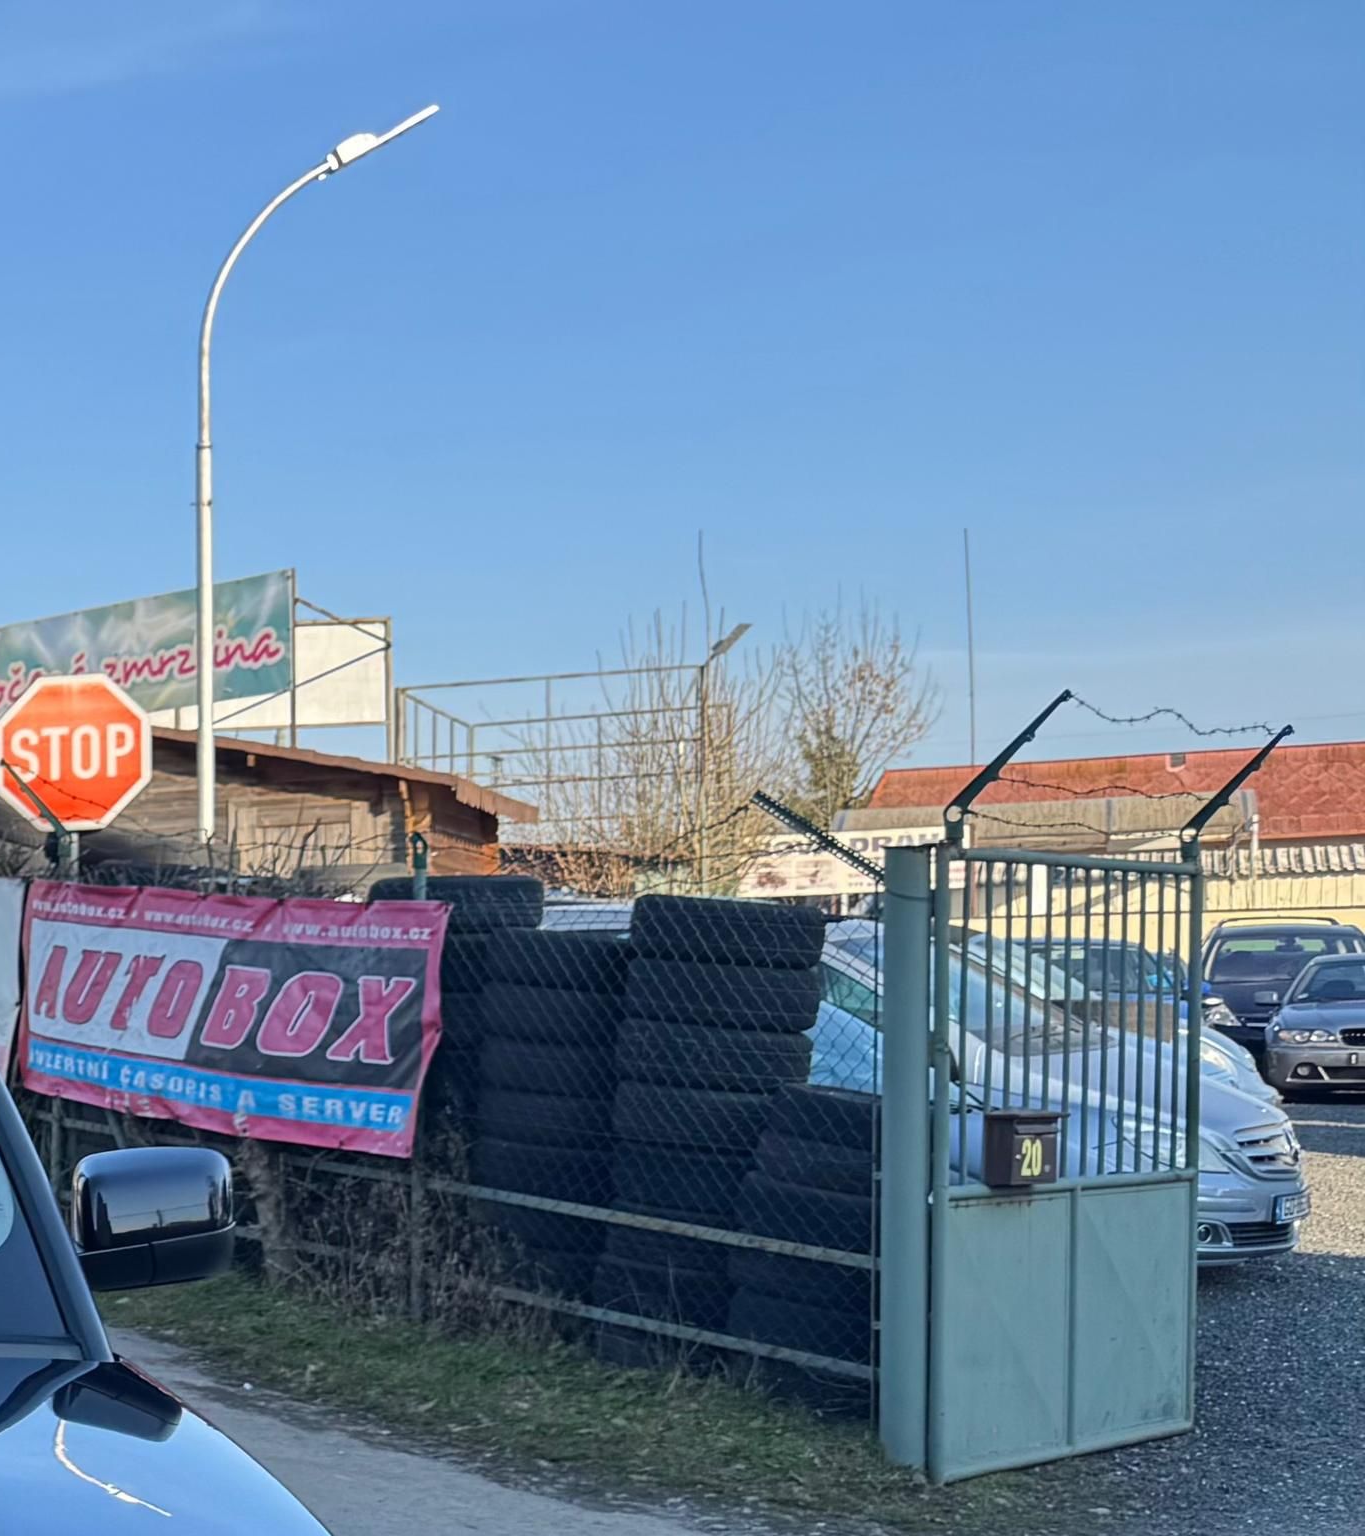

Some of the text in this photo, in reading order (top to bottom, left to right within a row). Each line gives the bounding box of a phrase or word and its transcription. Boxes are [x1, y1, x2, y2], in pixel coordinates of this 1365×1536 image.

[104, 630, 280, 684] zmrzina
[10, 723, 135, 784] STOP
[34, 944, 417, 1064] AUTOBOX
[120, 1064, 222, 1099] ČASOPIS
[237, 1089, 257, 1109] A
[278, 1093, 404, 1124] SERVER
[1021, 1139, 1042, 1176] 20
